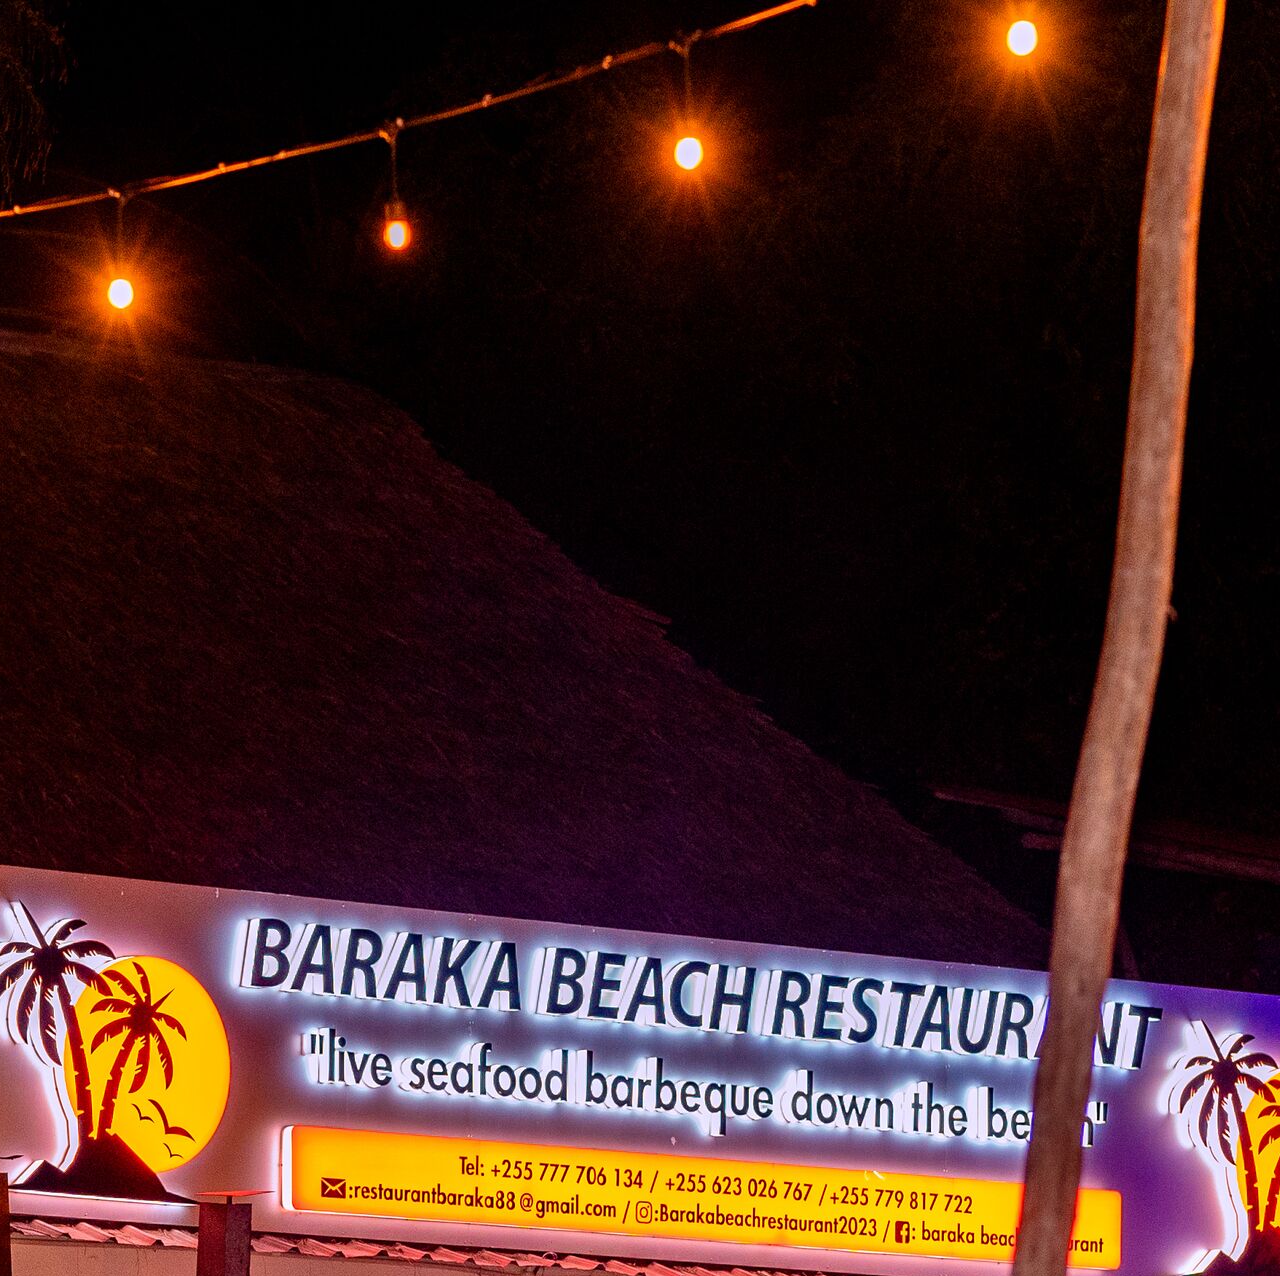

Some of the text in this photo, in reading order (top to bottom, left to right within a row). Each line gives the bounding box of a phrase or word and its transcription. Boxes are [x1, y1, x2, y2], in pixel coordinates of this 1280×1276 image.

[250, 917, 1163, 1069] BARAKA BEACH RESTAURNT
[409, 1042, 568, 1102] seafood
[586, 1049, 773, 1137] barbeque
[791, 1069, 893, 1130] down
[912, 1081, 967, 1138] the
[459, 1155, 485, 1177] Tel:
[491, 1159, 532, 1180] +255
[539, 1163, 570, 1183] 777
[576, 1165, 606, 1186] 706
[614, 1168, 643, 1189] 134
[665, 1173, 706, 1194] +255
[712, 1175, 742, 1196] 623
[748, 1178, 778, 1198] 026
[783, 1181, 813, 1202] 767
[875, 1189, 904, 1209] 779
[910, 1192, 937, 1211] 817
[944, 1194, 973, 1214] 722
[921, 1221, 975, 1244] baraka
[981, 1225, 1020, 1247] beac
